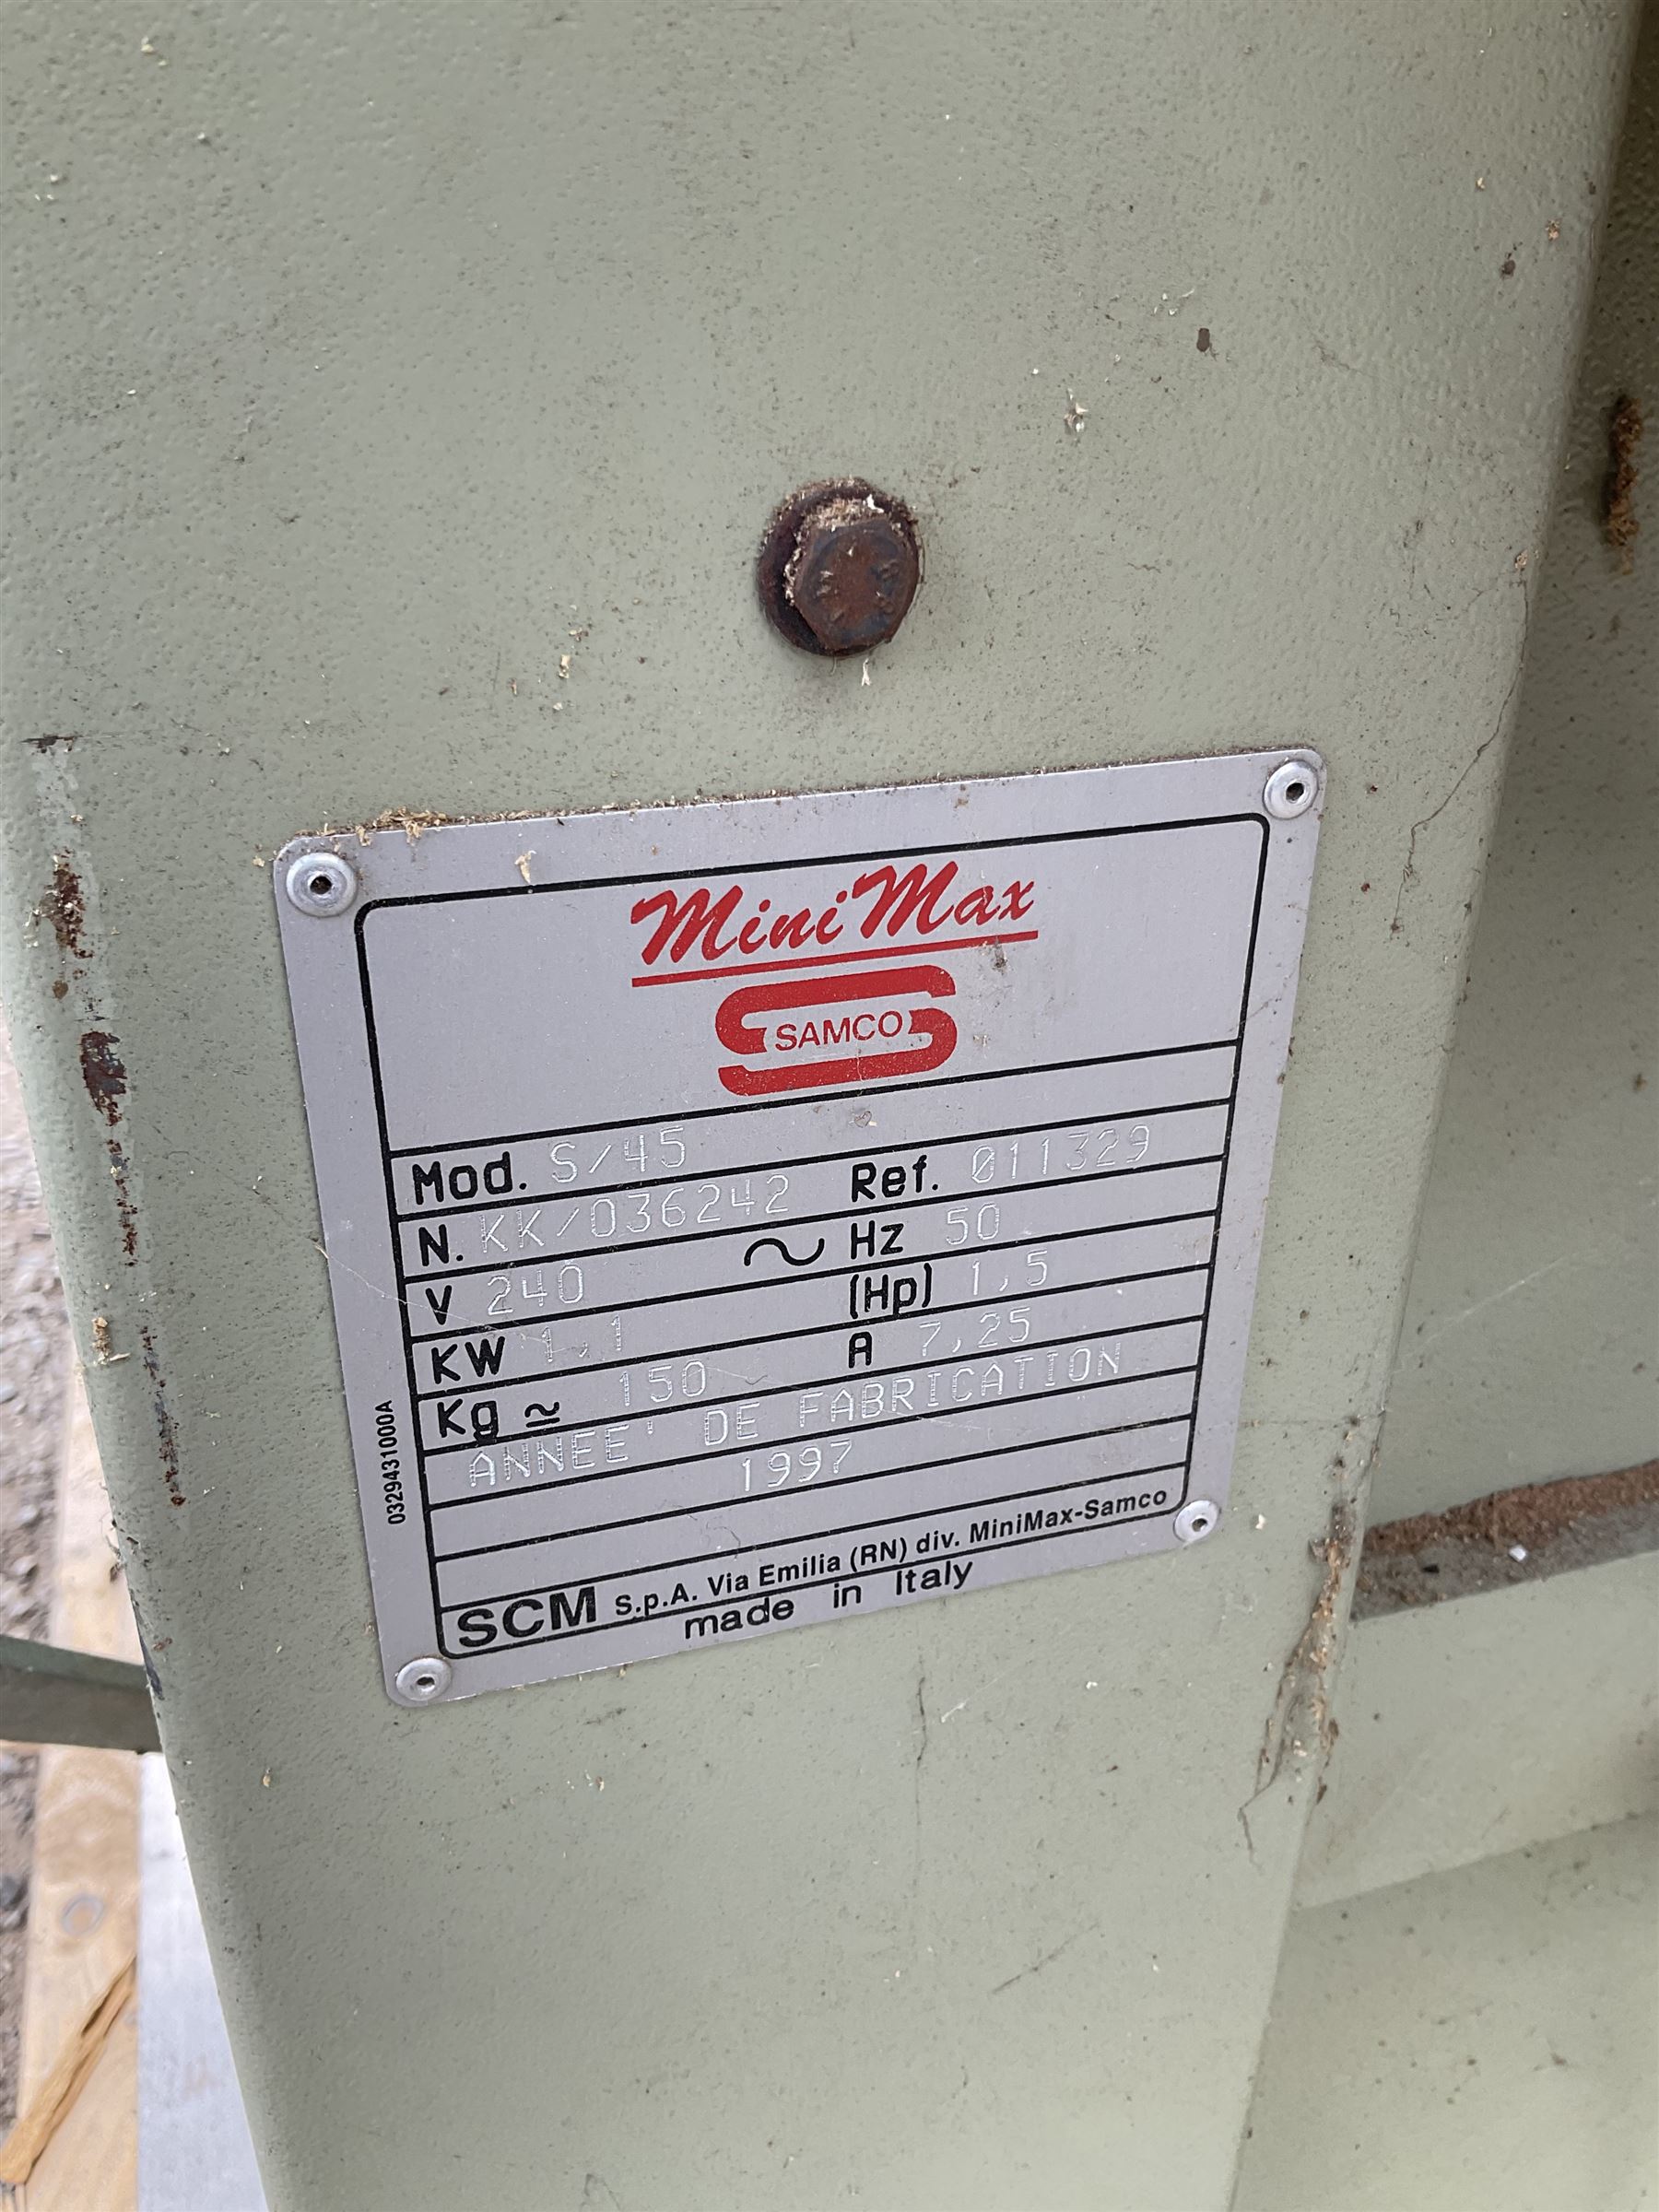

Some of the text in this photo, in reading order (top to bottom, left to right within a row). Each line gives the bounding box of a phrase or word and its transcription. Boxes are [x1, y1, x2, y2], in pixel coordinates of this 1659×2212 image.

[630, 861, 1035, 965] MiniMax
[775, 1010, 903, 1051] SAMCO
[412, 1126, 686, 1205] Mod. S/45
[851, 1125, 1150, 1202] Ref. 011329
[418, 1174, 790, 1266] N. KK/036242
[850, 1203, 1001, 1259] Hz 50
[425, 1264, 584, 1324] V 240
[850, 1250, 1048, 1319] (Hp) 1,5
[431, 1335, 505, 1384] KW
[848, 1307, 1031, 1368] A 7,25
[437, 1361, 706, 1443] Kg 150
[705, 1401, 760, 1446] DE
[799, 1342, 1121, 1428] FABRICATION
[375, 1400, 406, 1525] 0329431000A
[742, 1440, 853, 1491] 1997
[457, 1488, 1167, 1648] SCM S.p.A. Via Emilia (RN) div. MiniMax-Samco
[685, 1560, 973, 1640] made in Italy
